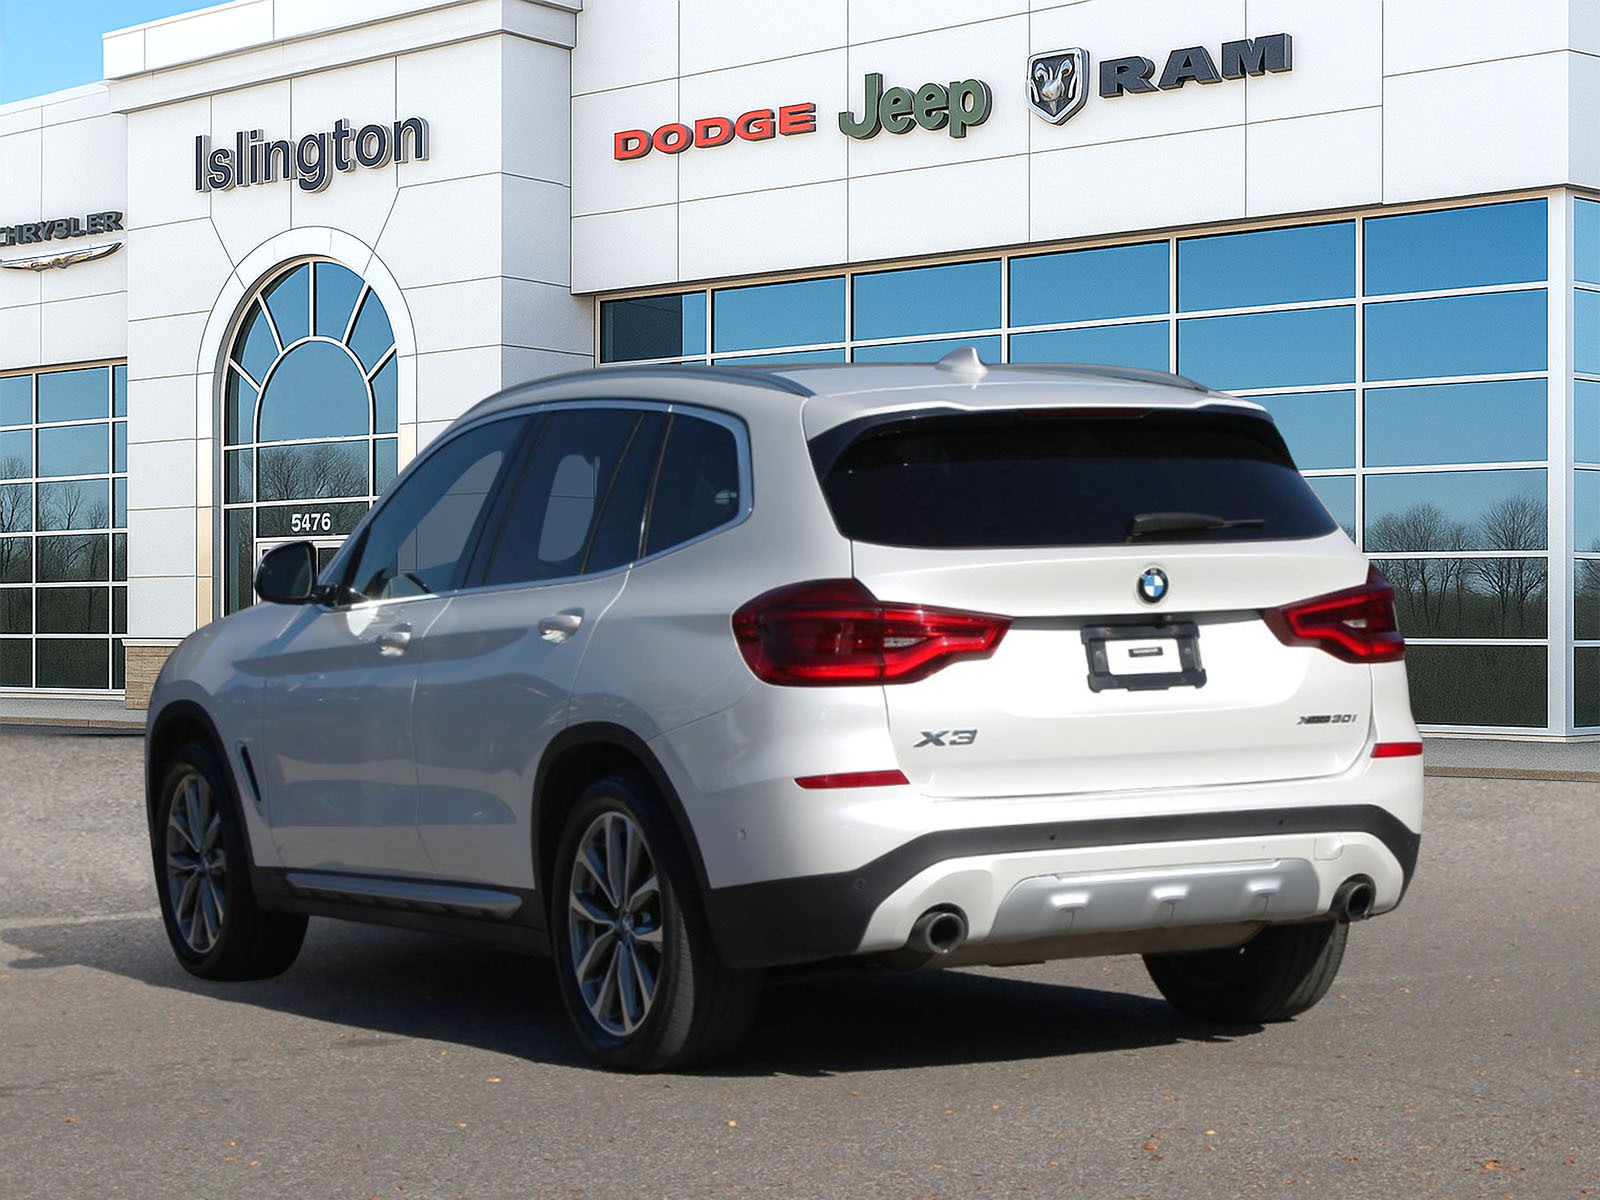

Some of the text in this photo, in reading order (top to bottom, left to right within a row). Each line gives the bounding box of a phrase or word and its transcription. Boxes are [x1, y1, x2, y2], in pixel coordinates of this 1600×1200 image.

[1101, 33, 1293, 97] RAM
[614, 102, 817, 160] DODGE
[839, 72, 991, 139] Jeep
[195, 115, 430, 192] Islington
[292, 512, 332, 532] 5476
[913, 728, 978, 748] X3
